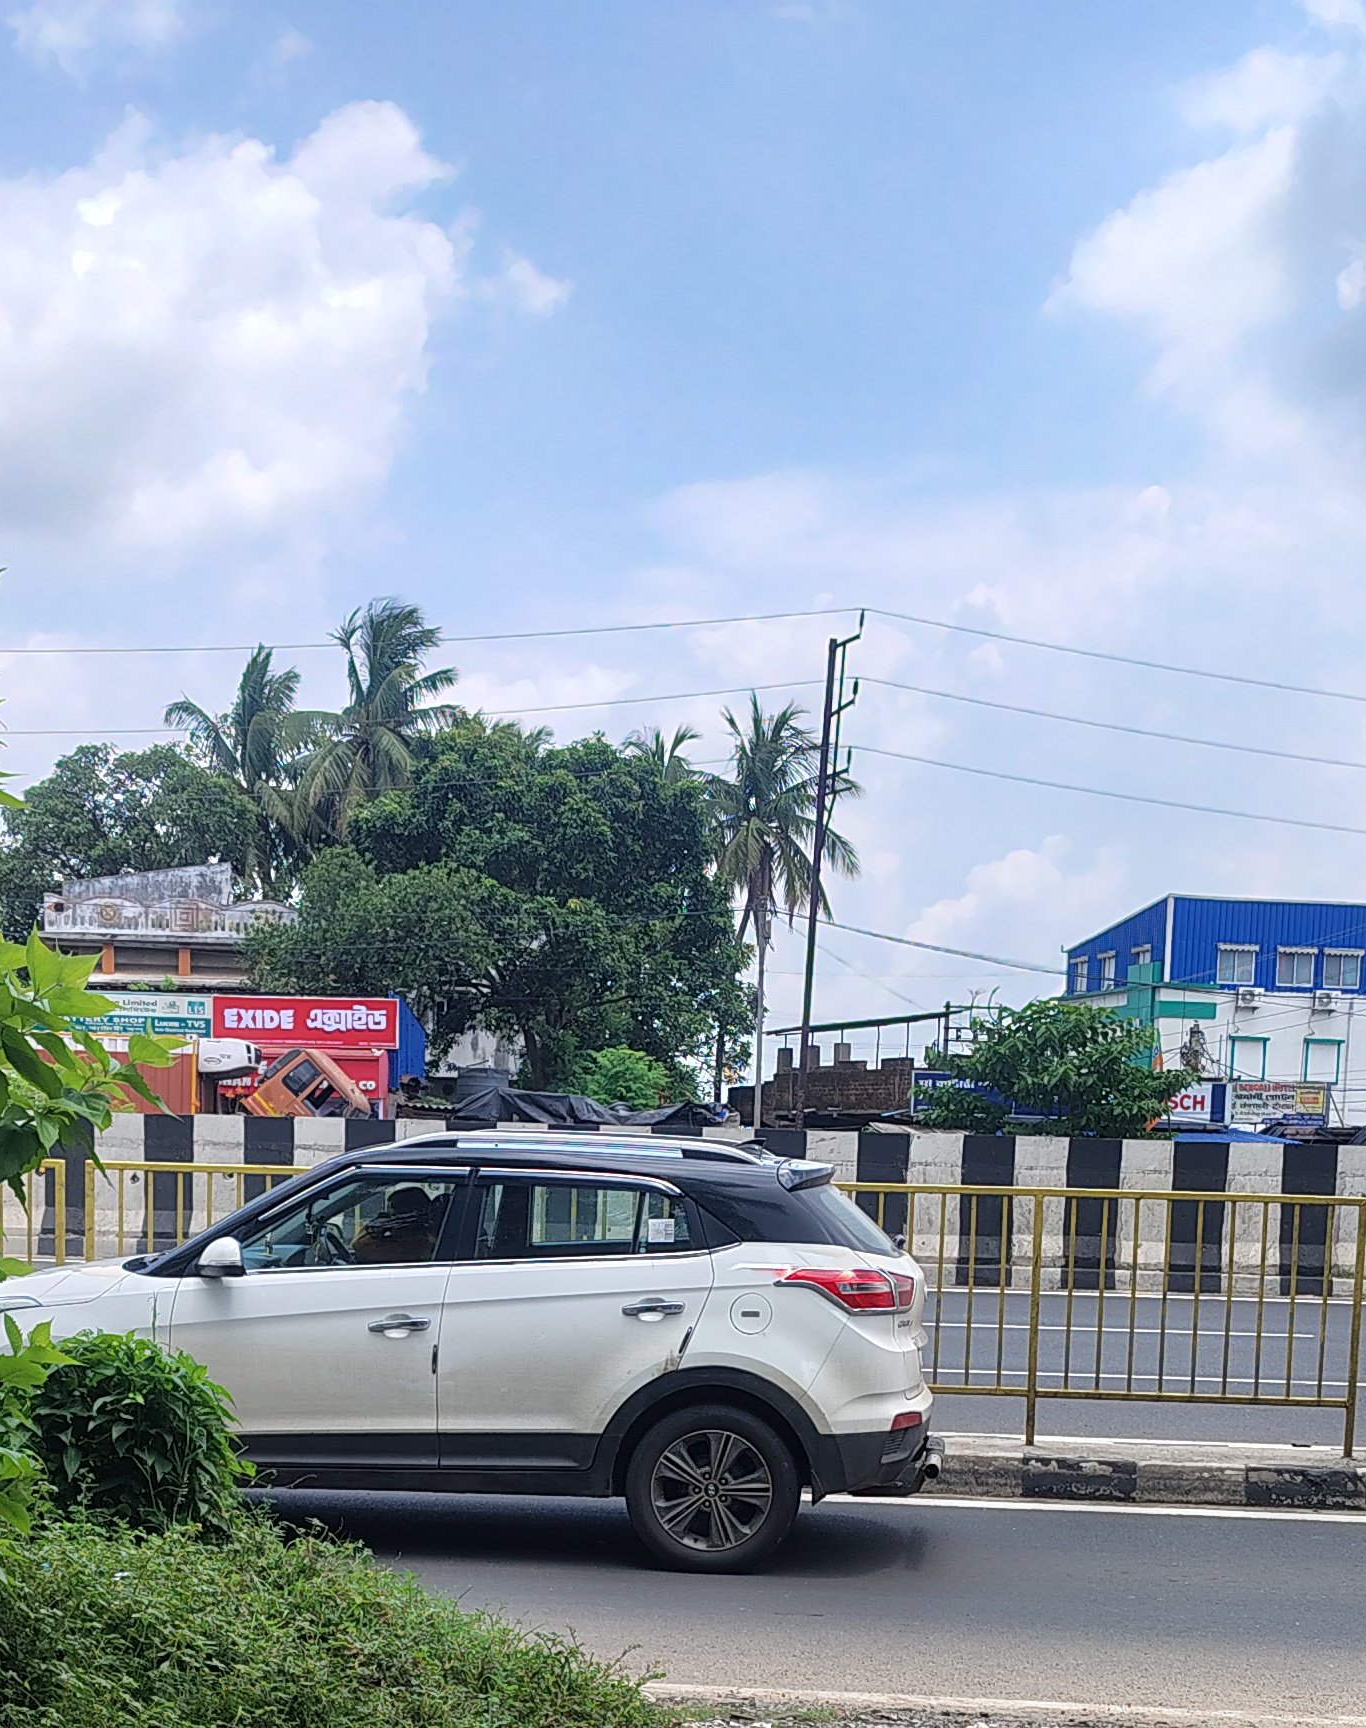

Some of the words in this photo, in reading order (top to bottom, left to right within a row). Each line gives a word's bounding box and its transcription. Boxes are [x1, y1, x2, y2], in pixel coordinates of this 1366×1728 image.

[123, 999, 158, 1007] Limited
[187, 1020, 206, 1028] TVS
[223, 1008, 295, 1030] EXIDE
[306, 1005, 387, 1032] এক্সাইড
[1168, 1093, 1205, 1112] SCH
